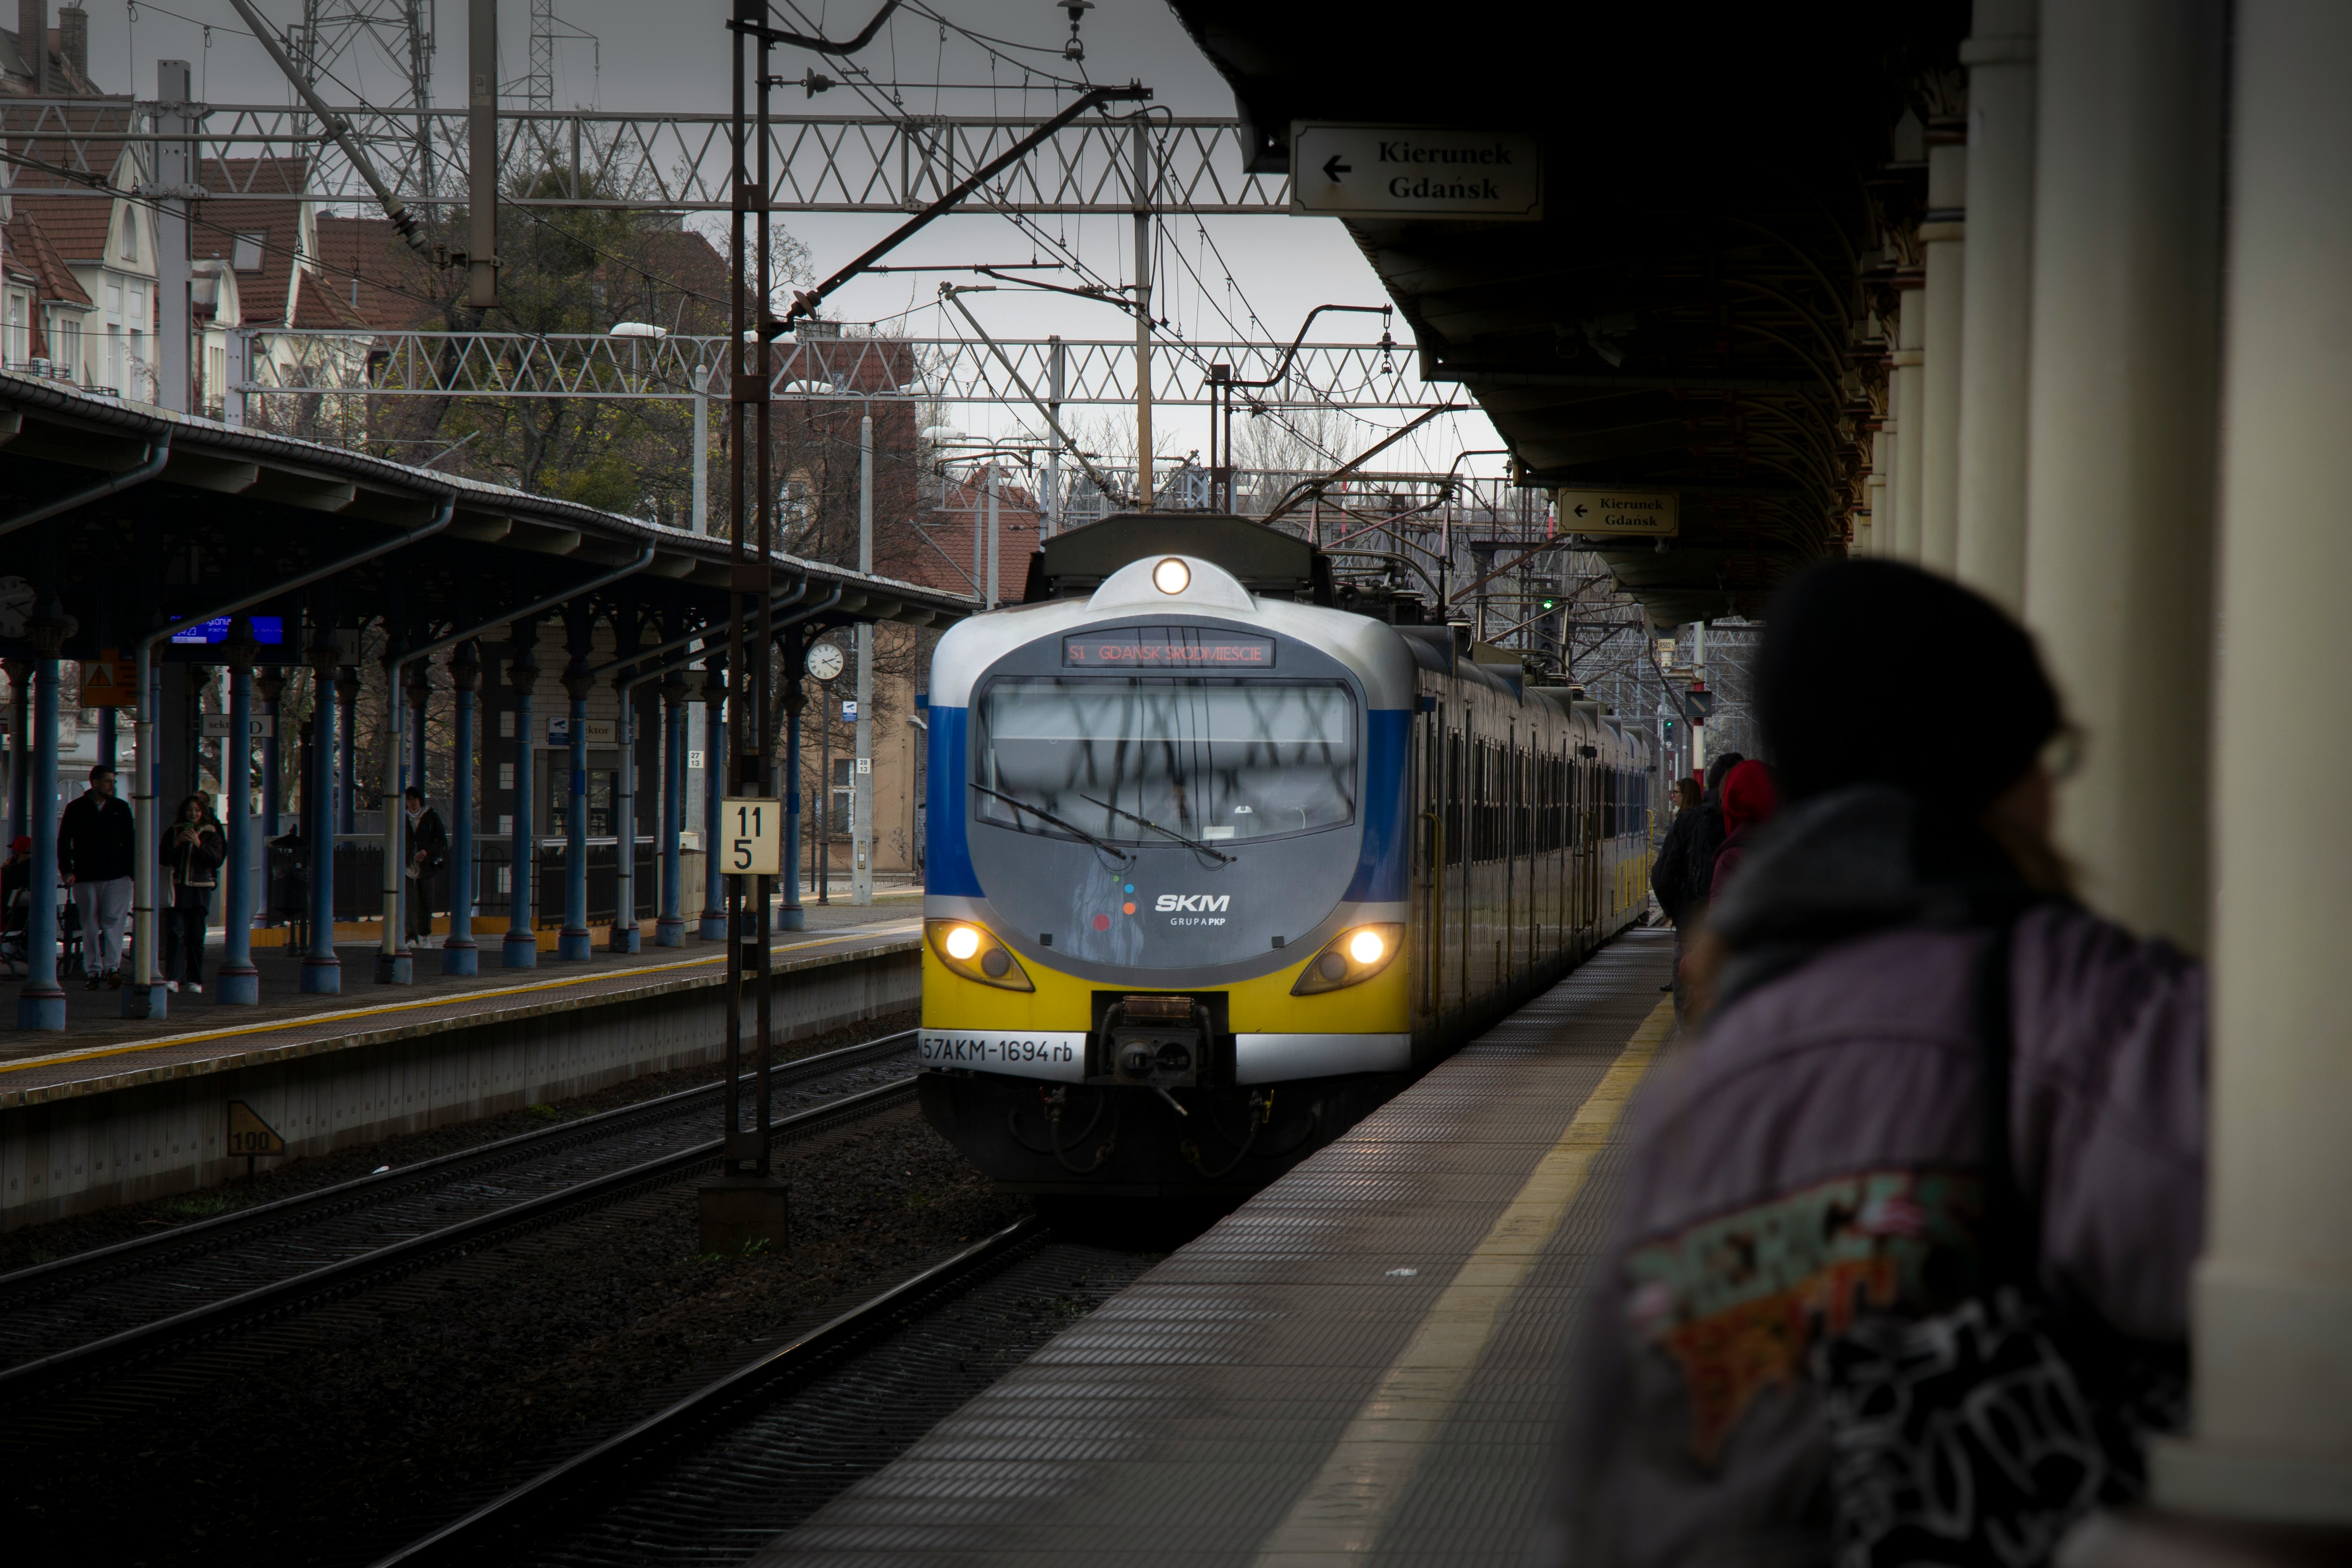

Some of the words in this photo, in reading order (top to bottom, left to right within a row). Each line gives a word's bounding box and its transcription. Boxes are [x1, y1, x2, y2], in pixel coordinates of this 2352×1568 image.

[1378, 142, 1513, 165] Kierunek
[1389, 176, 1499, 199] Gdańsk
[1600, 498, 1664, 510] Kierunek
[1605, 514, 1657, 526] Gdańsk
[1069, 646, 1085, 660] S1
[250, 721, 262, 734] D
[737, 807, 761, 837] 11
[734, 839, 752, 870] 5
[1155, 894, 1230, 912] SKM
[232, 1132, 270, 1151] 100
